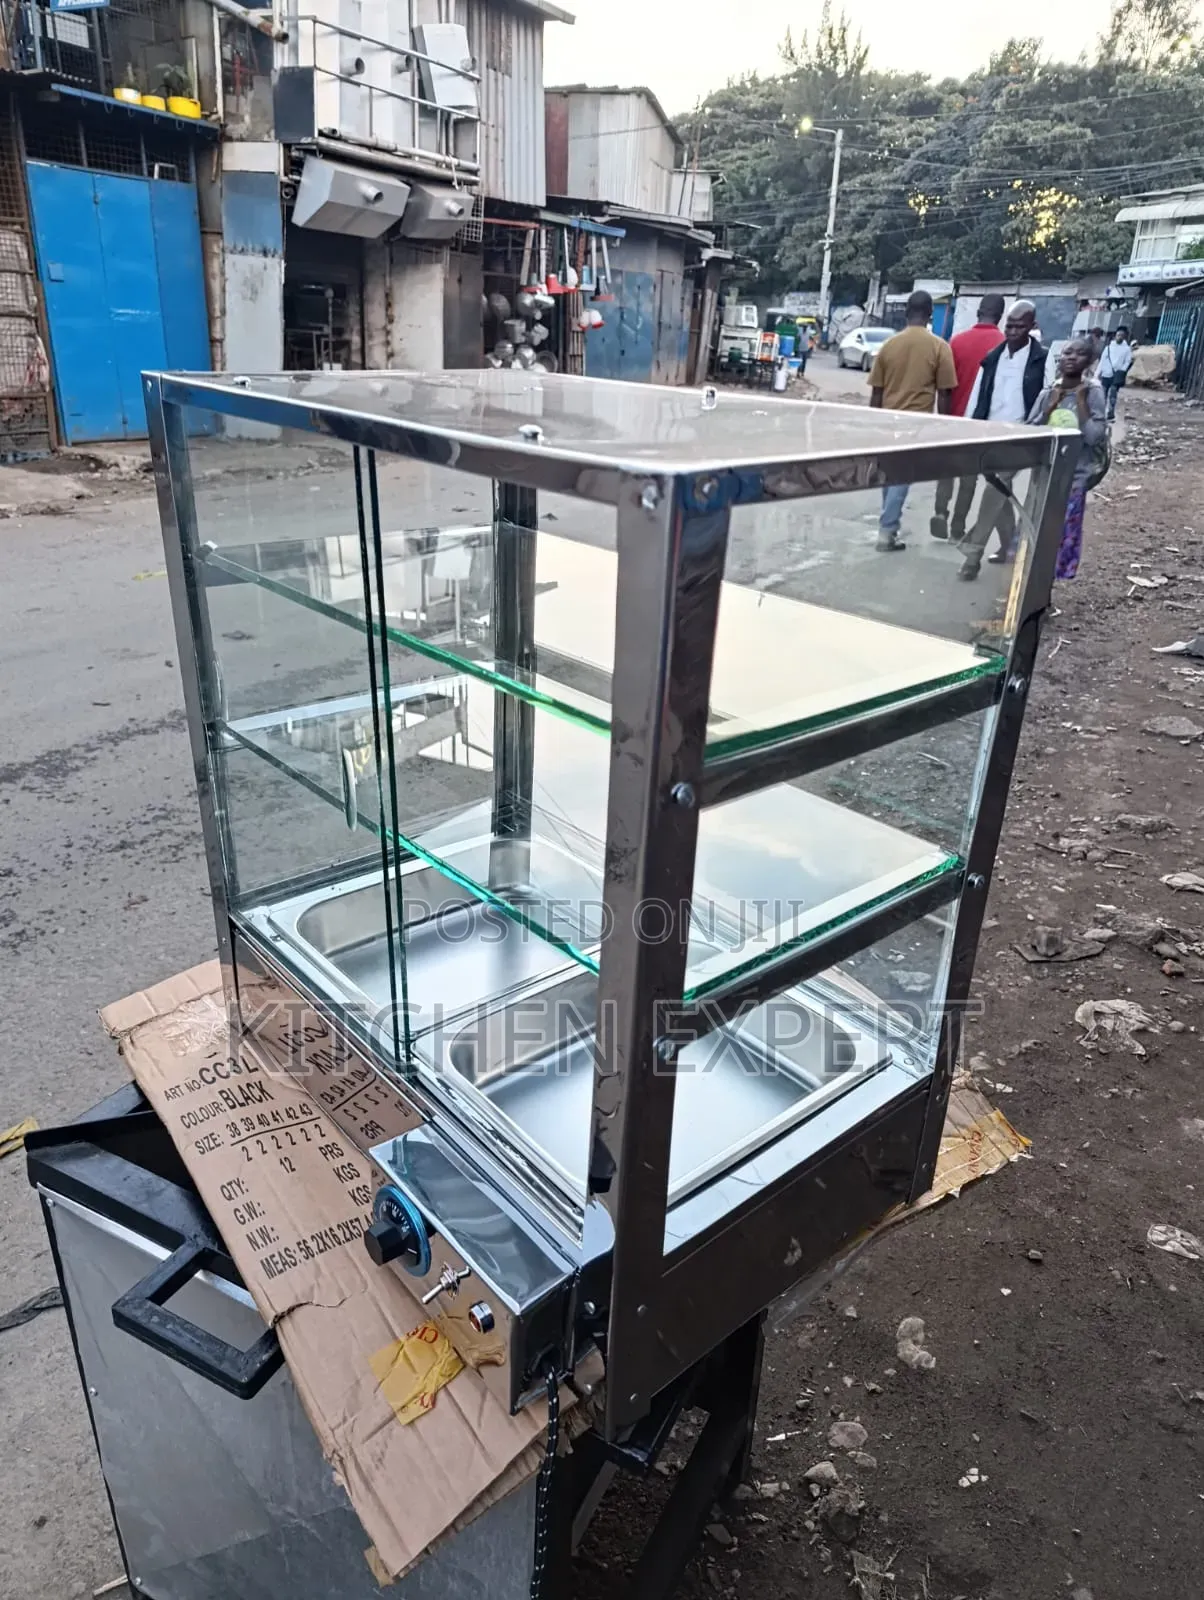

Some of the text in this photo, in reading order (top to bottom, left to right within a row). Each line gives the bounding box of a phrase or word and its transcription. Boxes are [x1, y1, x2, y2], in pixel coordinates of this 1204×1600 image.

[163, 1085, 185, 1101] ART
[180, 1080, 275, 1129] COLOUR: BLACK
[195, 1103, 313, 1155] SIZE: 38 39 40 41 42 43
[241, 1123, 326, 1162] 2 2 2 2 2 2
[220, 1142, 345, 1202] QTY: 12 PRS
[333, 1162, 361, 1184] KGS
[347, 1184, 372, 1207] KGS
[260, 1248, 302, 1280] MEAS:
